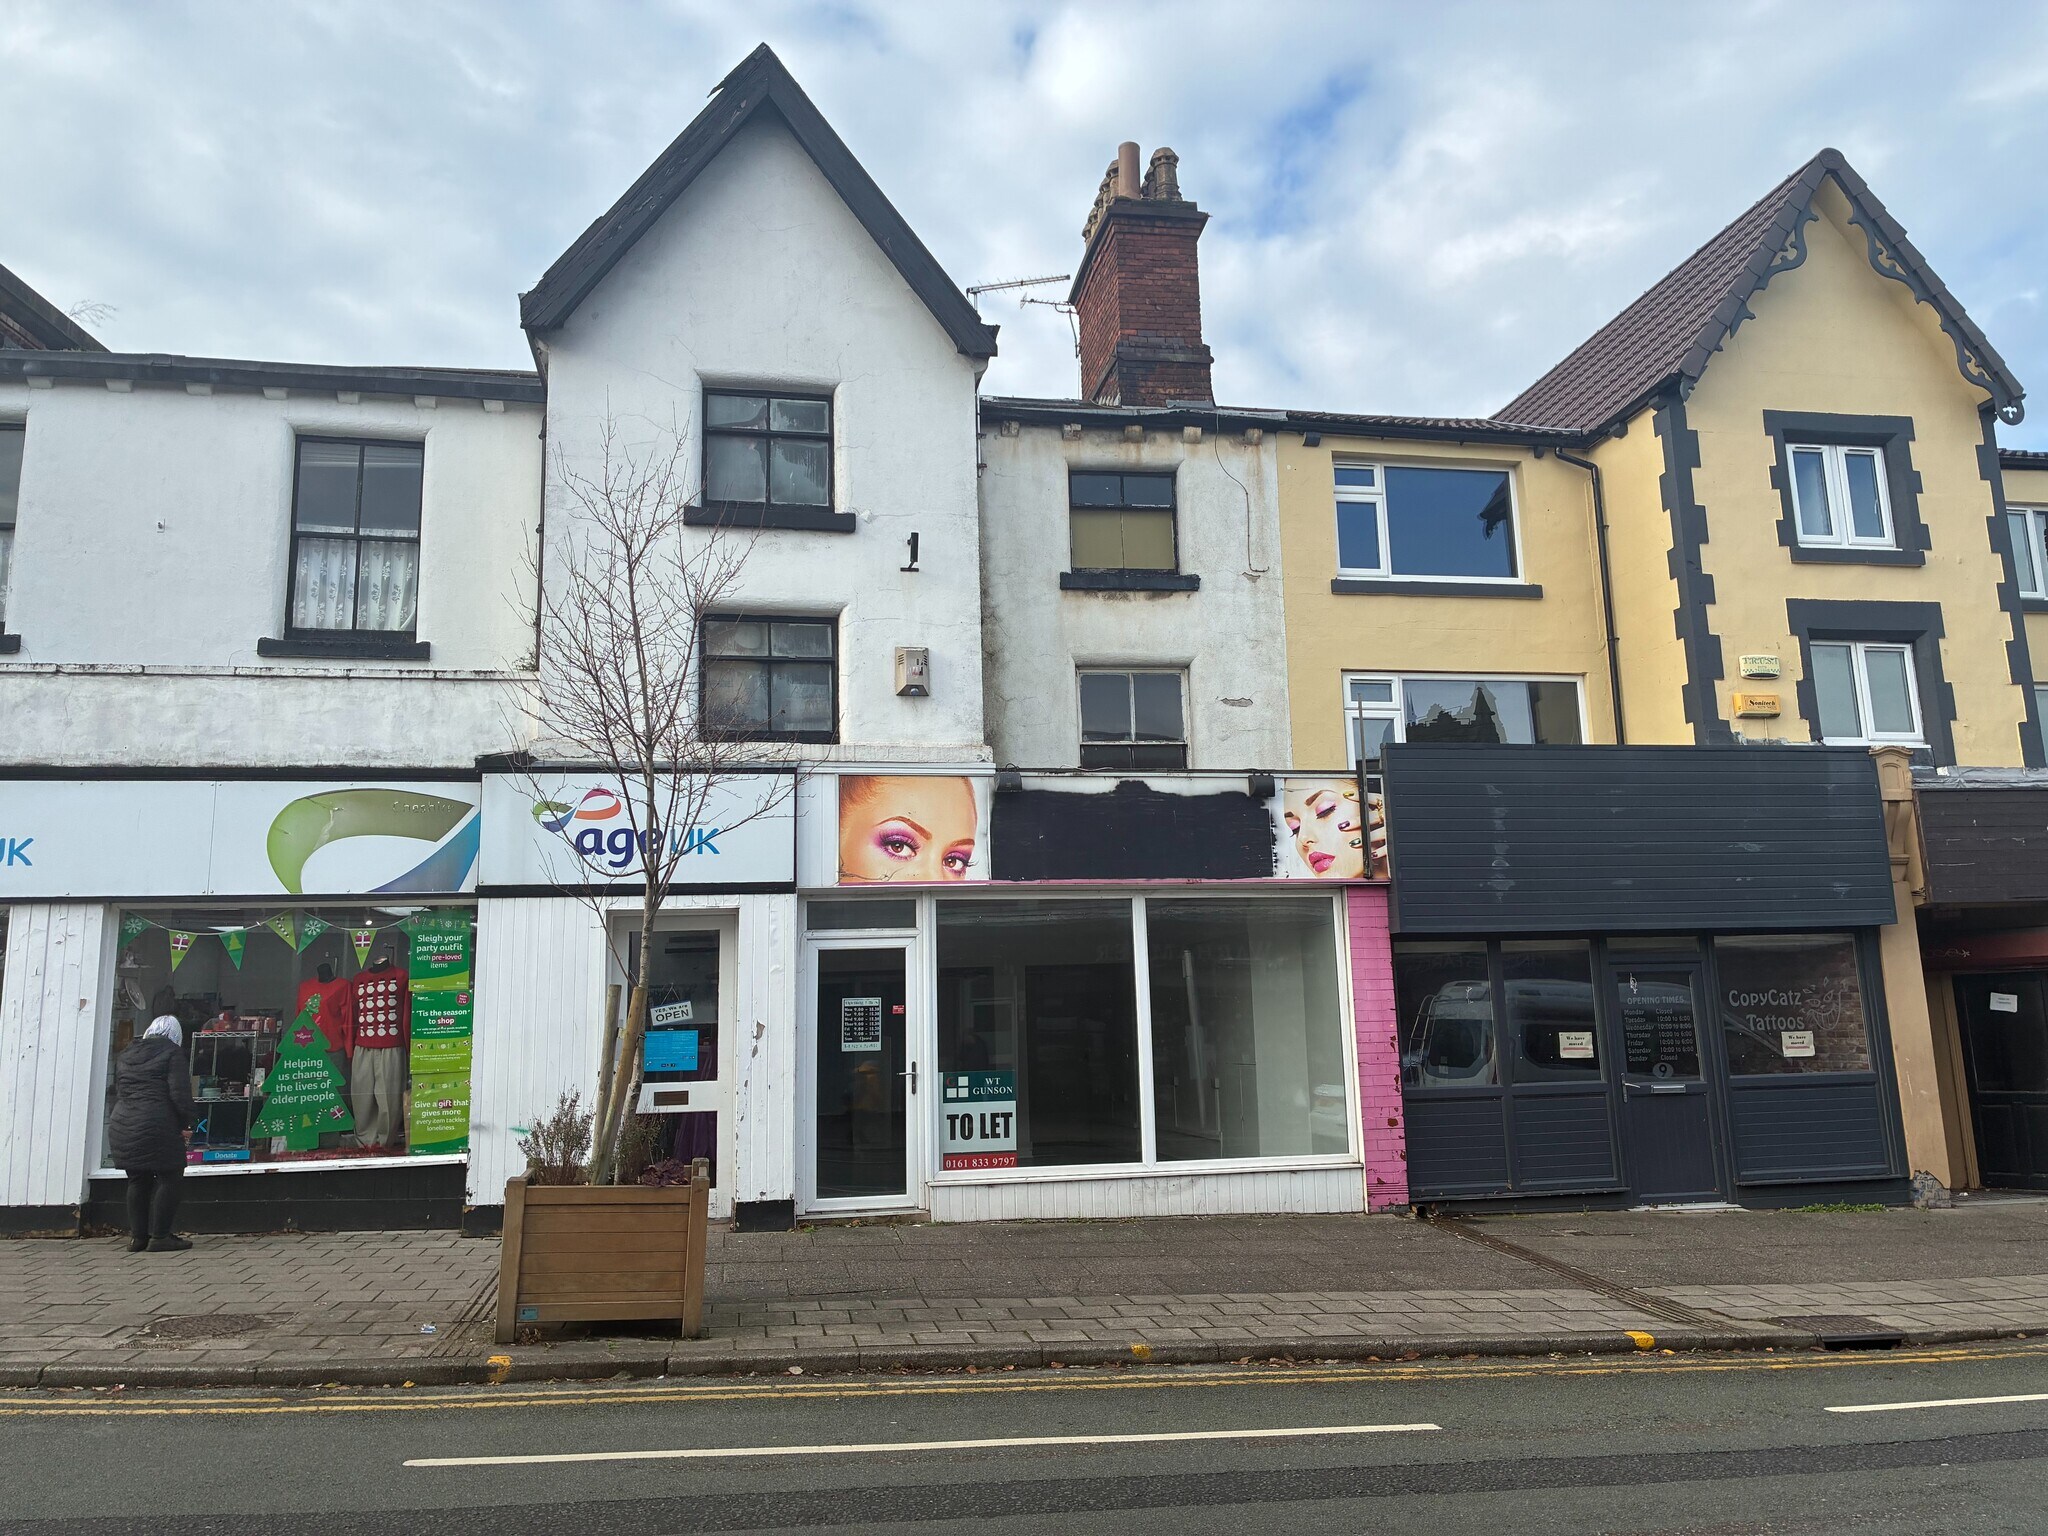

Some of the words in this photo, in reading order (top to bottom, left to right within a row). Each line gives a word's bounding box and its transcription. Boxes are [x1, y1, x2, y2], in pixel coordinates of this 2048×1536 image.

[575, 828, 664, 868] age
[418, 934, 442, 943] Sleigh
[444, 935, 463, 943] your
[416, 945, 438, 953] party
[440, 943, 462, 951] outfit
[1627, 996, 1660, 1004] OPENING
[656, 1009, 689, 1022] OPEN
[1746, 1014, 1804, 1031] Tattoos
[284, 1058, 323, 1069] Helping
[292, 1070, 329, 1080] change
[1658, 1064, 1667, 1077] 9
[276, 1084, 292, 1092] the
[295, 1082, 317, 1091] lives
[321, 1079, 332, 1089] of
[973, 1086, 1013, 1094] GUNSON
[272, 1095, 298, 1104] older
[300, 1091, 335, 1104] people
[438, 1100, 452, 1108] gift
[946, 1113, 973, 1140] TO
[980, 1112, 1013, 1139] LET
[946, 1159, 968, 1168] 0161
[992, 1157, 1014, 1166] 9797
